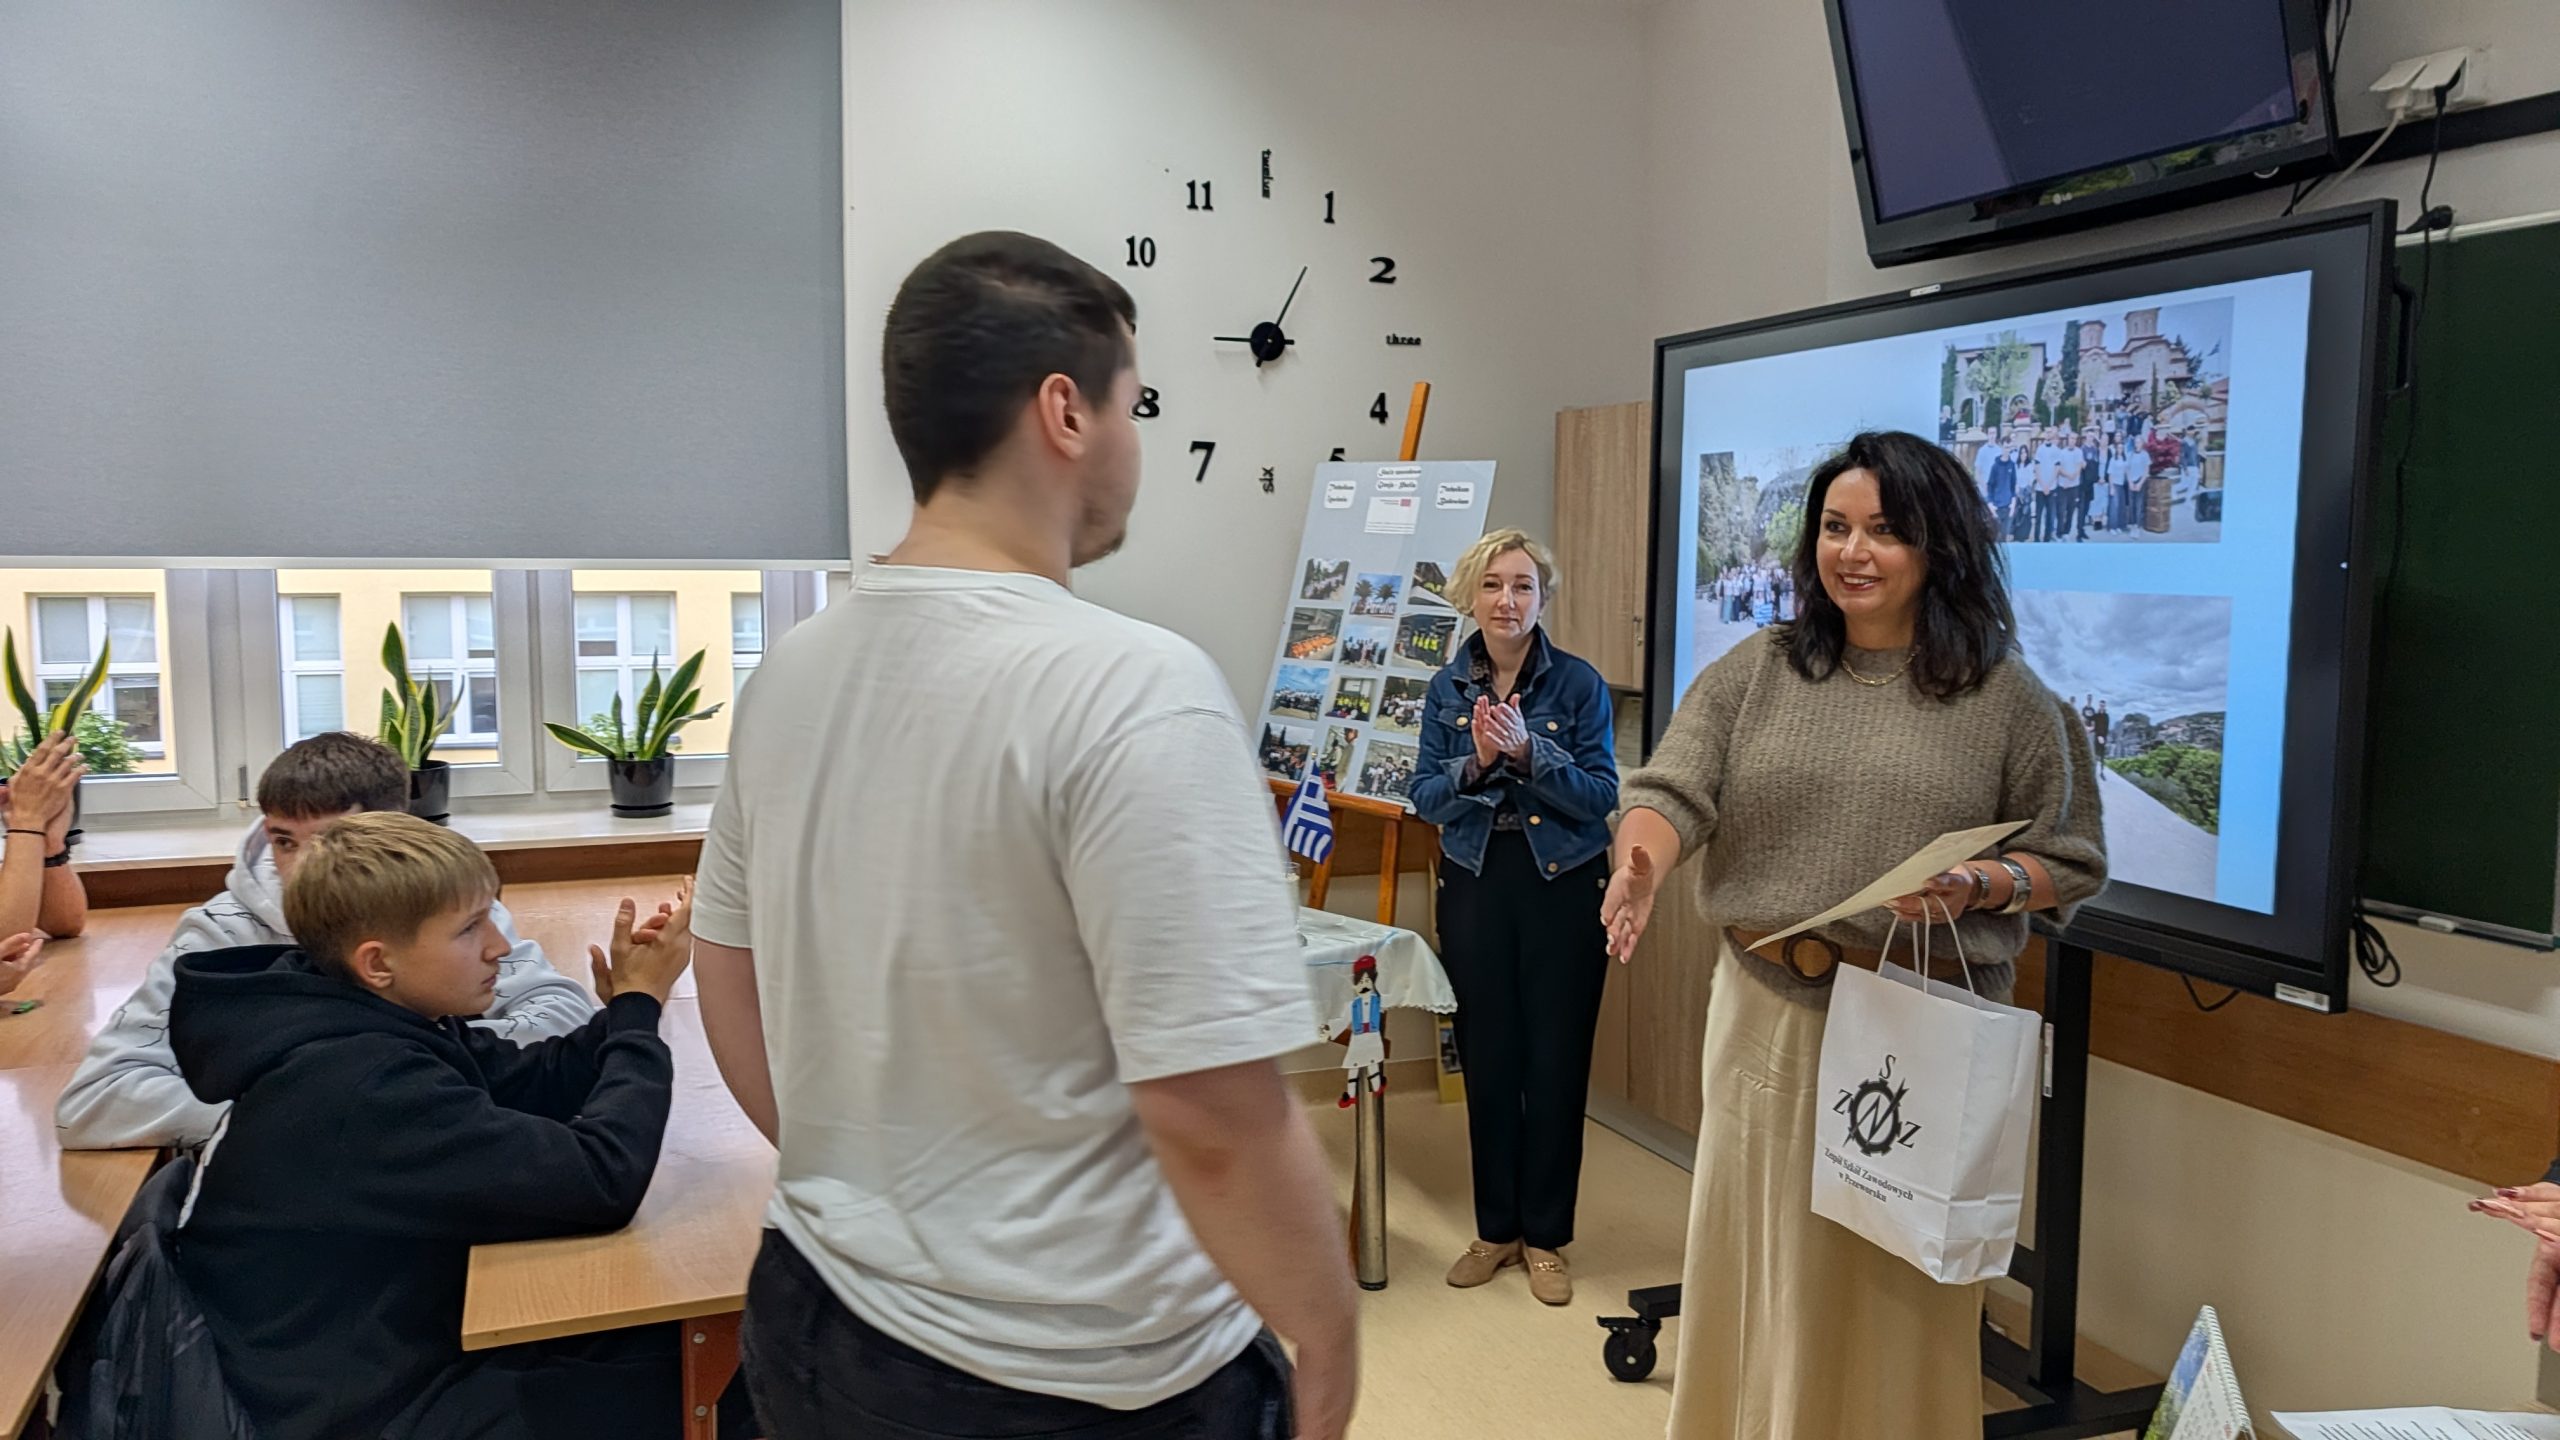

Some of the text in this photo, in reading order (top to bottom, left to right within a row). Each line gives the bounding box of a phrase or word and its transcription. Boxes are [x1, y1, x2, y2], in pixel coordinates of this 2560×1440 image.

[1261, 149, 1274, 199] twelve
[1186, 180, 1214, 211] 11
[1323, 191, 1335, 223] 1
[1126, 235, 1156, 267] 10
[1369, 256, 1397, 284] 2
[1386, 334, 1421, 346] three
[1132, 387, 1160, 418] 8
[1369, 392, 1388, 424] 4
[1189, 440, 1216, 482] 7
[1259, 466, 1274, 493] six
[1878, 1054, 1896, 1079] S
[1832, 1088, 1852, 1115] Z
[1897, 1121, 1922, 1148] Z
[1861, 1169, 1914, 1201] Zawodowych
